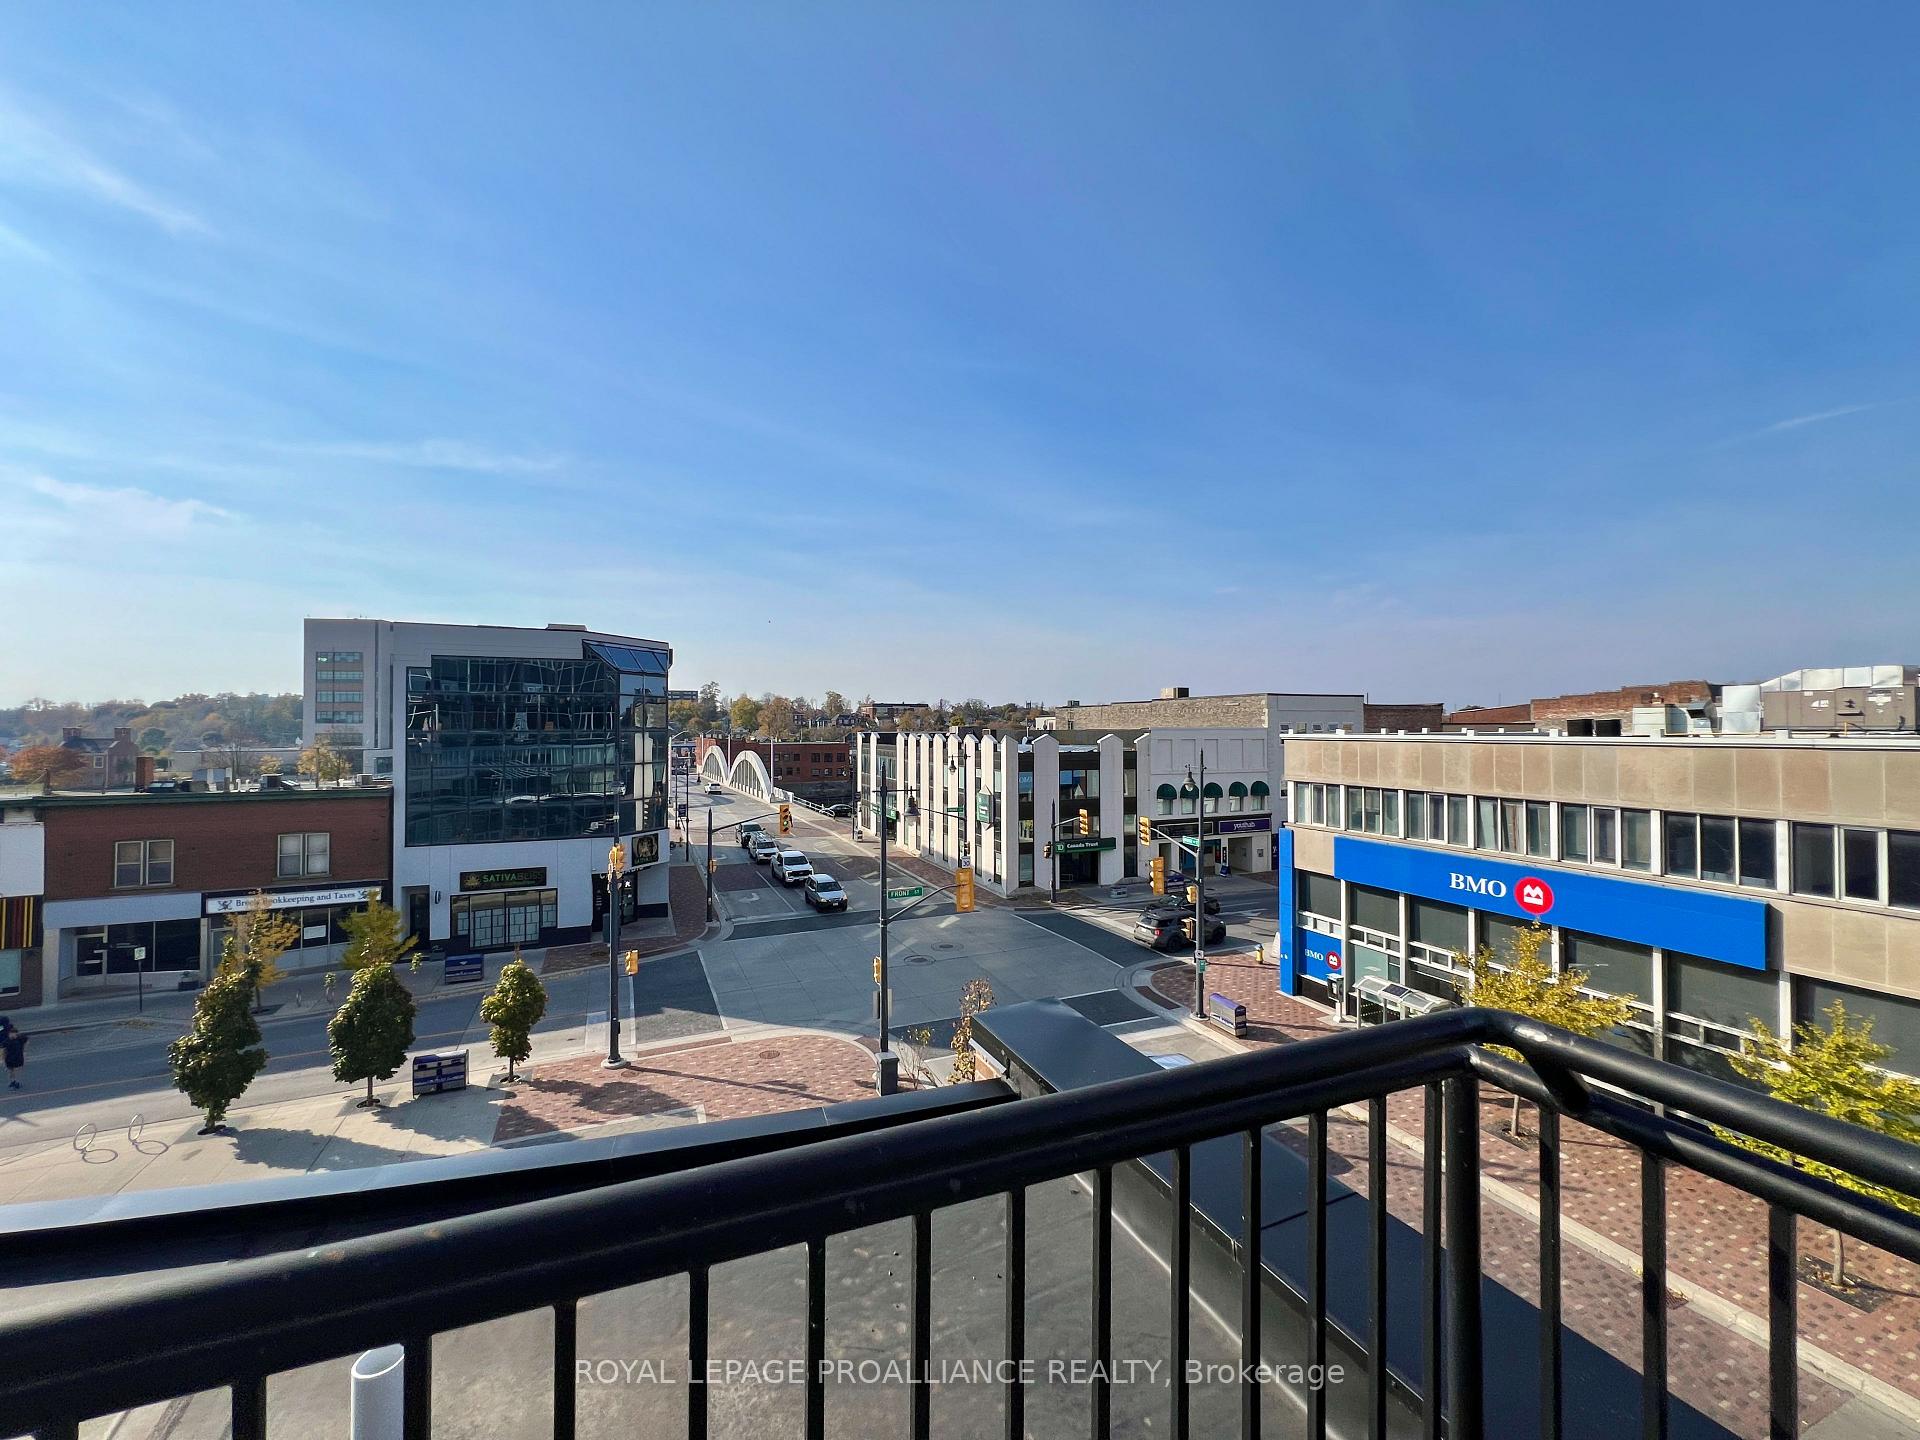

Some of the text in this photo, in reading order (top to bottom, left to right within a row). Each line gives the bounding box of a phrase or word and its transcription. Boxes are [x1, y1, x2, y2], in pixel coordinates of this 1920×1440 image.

[1449, 872, 1507, 898] BMO
[334, 891, 356, 900] Taxes
[890, 889, 910, 898] FRONT
[1305, 949, 1324, 961] BMO
